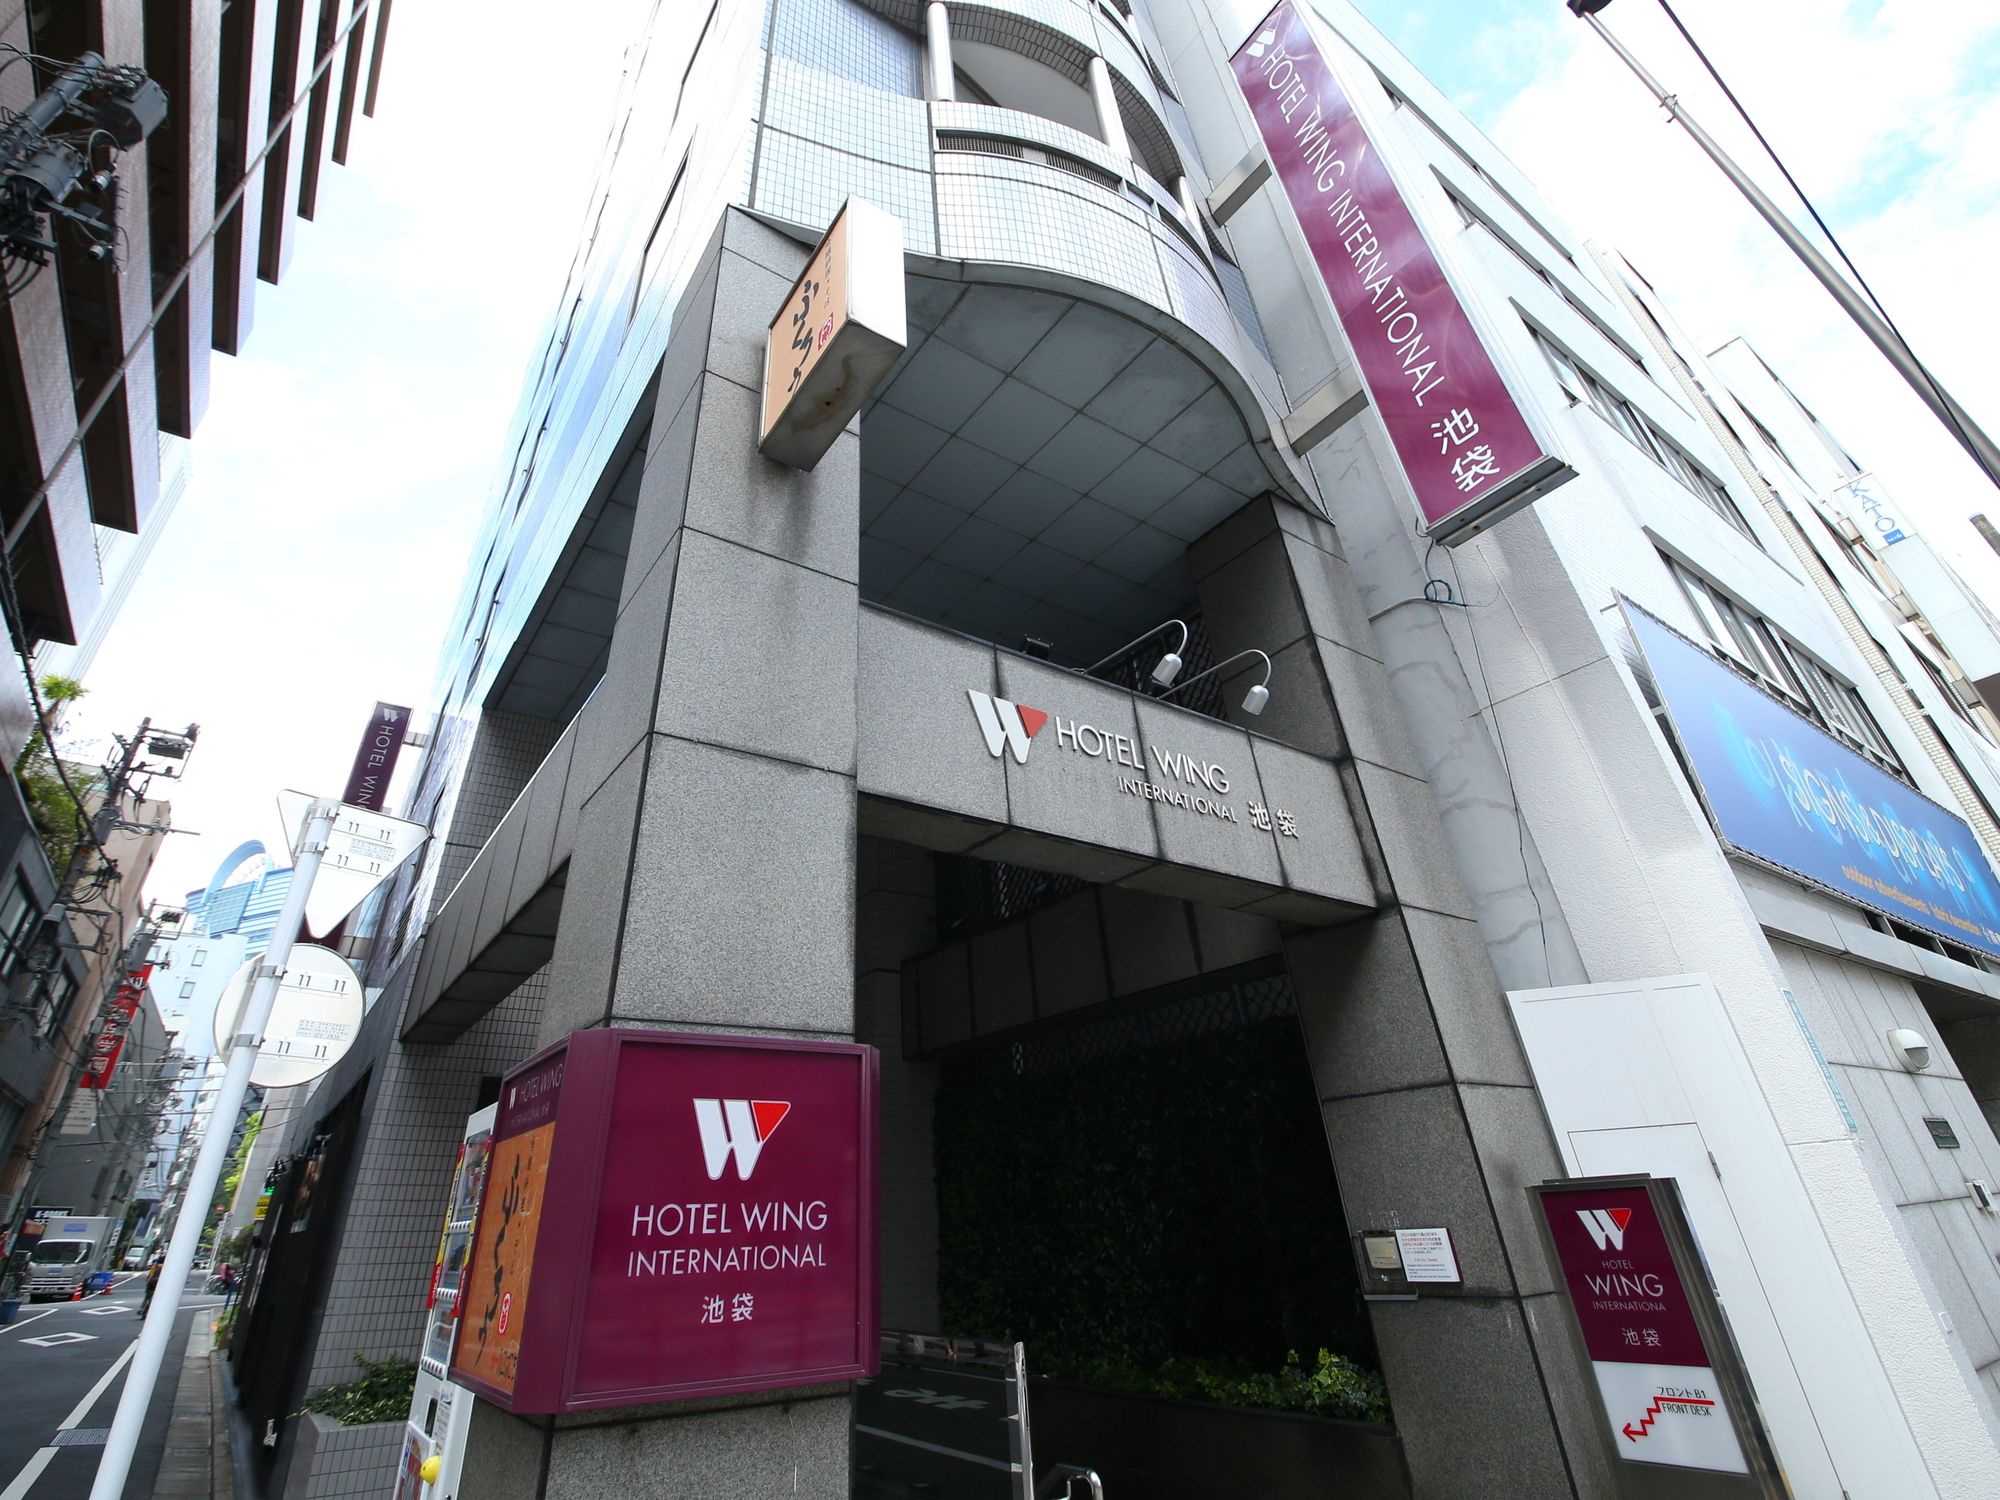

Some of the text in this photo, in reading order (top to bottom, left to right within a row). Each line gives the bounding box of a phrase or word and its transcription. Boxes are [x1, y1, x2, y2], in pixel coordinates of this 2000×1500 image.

[1261, 43, 1309, 124] HOTEL
[1295, 109, 1346, 193] WING
[1327, 188, 1445, 407] INTERNATIONAL
[1430, 407, 1501, 493] 池袋
[1845, 480, 1896, 532] KATO
[367, 725, 394, 768] HOTEL
[1055, 716, 1145, 770] HOTEL
[1152, 745, 1230, 794] WING
[356, 775, 379, 809] WIN
[1118, 776, 1238, 823] INTERNATIONAL
[1248, 800, 1300, 838] 池袋
[519, 1075, 539, 1104] HOTEL
[539, 1063, 564, 1094] WING
[631, 1200, 828, 1237] HOTEL WING
[627, 1243, 827, 1278] INTERNATIONAL
[1601, 1259, 1634, 1270] HOTEL
[1584, 1273, 1664, 1297] WING
[700, 1292, 754, 1325] 池袋
[1592, 1301, 1667, 1312] INTERNATIONA
[1621, 1327, 1661, 1347] 池袋
[1656, 1386, 1706, 1399] フロント B1
[1661, 1402, 1713, 1417] FRONT DESK
